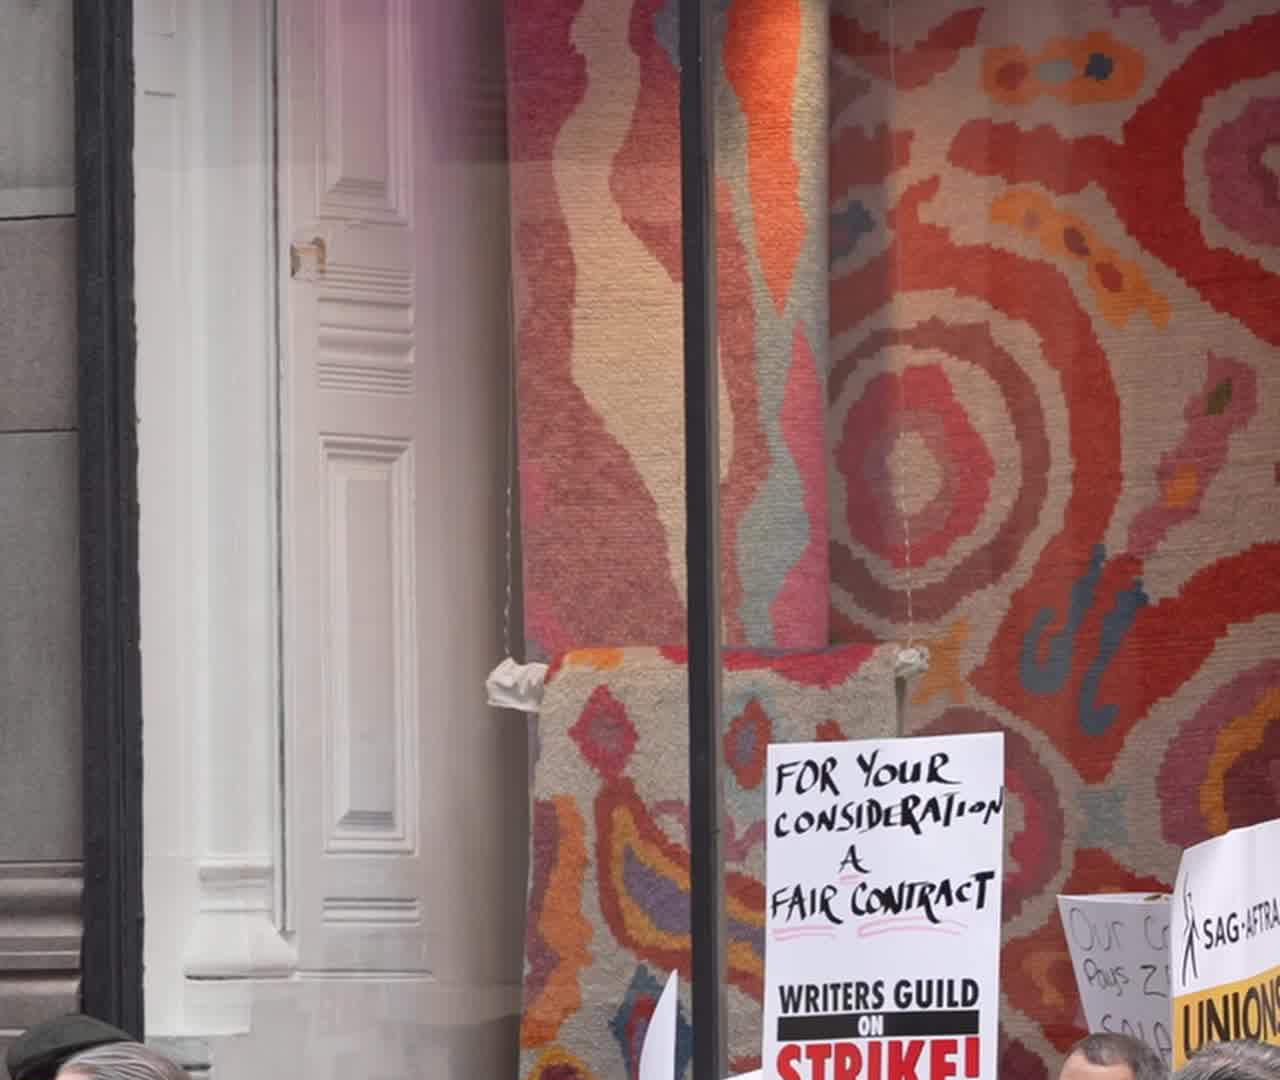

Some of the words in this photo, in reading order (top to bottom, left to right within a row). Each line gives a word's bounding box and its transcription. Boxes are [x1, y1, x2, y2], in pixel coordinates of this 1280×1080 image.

[776, 756, 840, 797] FOR
[839, 844, 871, 874] A
[771, 884, 844, 925] FAIR
[779, 980, 885, 1014] WRITERS
[893, 978, 981, 1010] GUILD
[858, 1015, 884, 1036] ON
